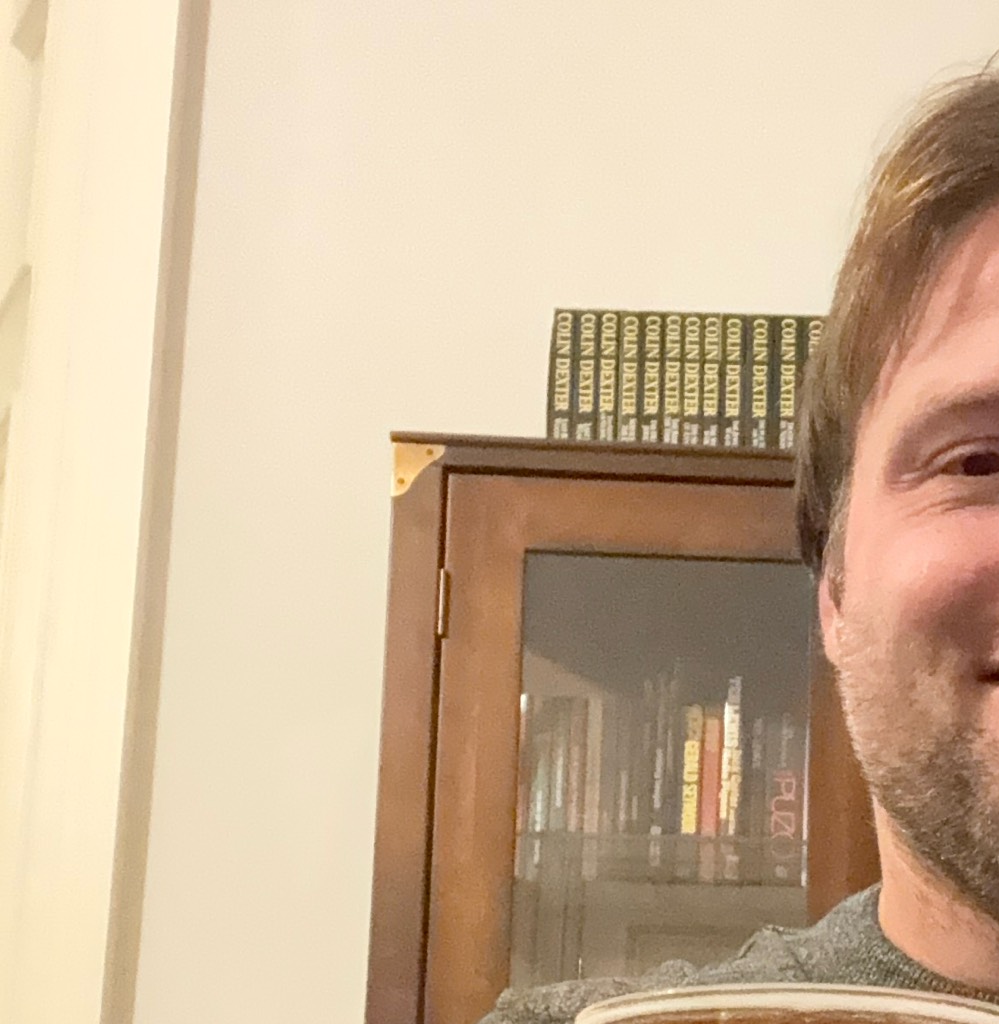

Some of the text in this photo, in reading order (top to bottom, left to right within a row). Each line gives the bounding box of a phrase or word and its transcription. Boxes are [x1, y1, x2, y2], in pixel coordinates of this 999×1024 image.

[556, 312, 572, 355] COLIN
[579, 313, 596, 356] COLIN
[601, 312, 617, 356] COLIN
[623, 316, 639, 358] COLIN
[645, 315, 661, 358] COLIN
[665, 315, 681, 358] COLIN
[685, 317, 701, 359] COLIN
[704, 317, 720, 360] COLIN
[726, 318, 742, 361] COLIN
[752, 318, 768, 361] COLIN
[780, 318, 797, 361] COLIN
[554, 358, 570, 411] DEXTER
[578, 359, 594, 413] DEXTER
[599, 358, 615, 412] DEXTER
[621, 362, 638, 415] DEXTER
[643, 361, 660, 414] DEXTER
[664, 361, 680, 414] DEXTER
[683, 362, 699, 416] DEXTER
[703, 363, 719, 416] DEXTER
[725, 364, 740, 418] DEXTER
[751, 365, 768, 418] DEXTER
[779, 364, 796, 417] DEXTER
